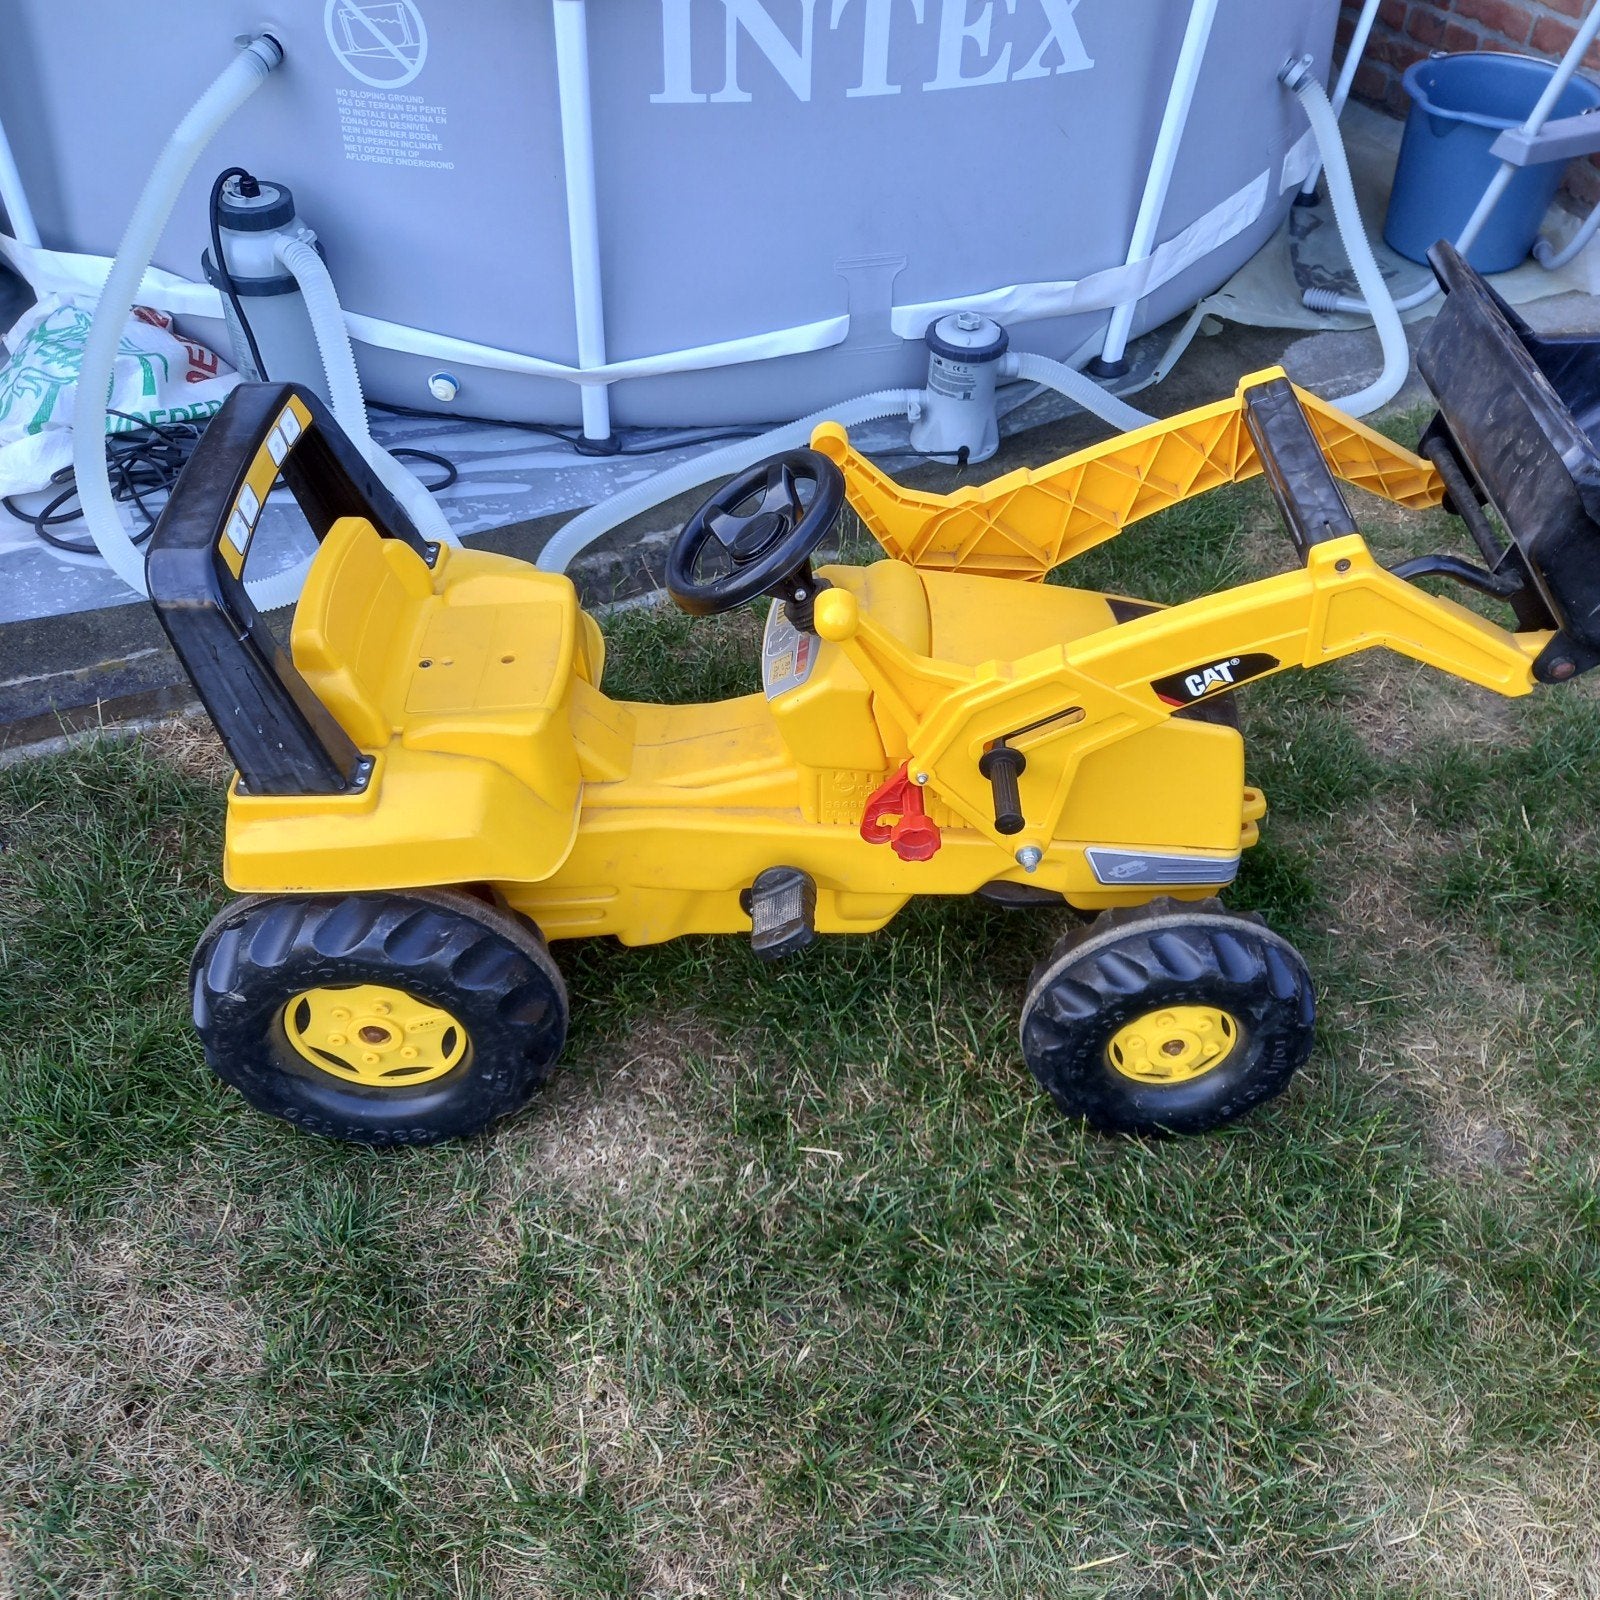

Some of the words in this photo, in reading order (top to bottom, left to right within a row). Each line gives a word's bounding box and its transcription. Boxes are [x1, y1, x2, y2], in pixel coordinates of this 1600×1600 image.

[649, 0, 1096, 103] INTEX
[336, 88, 348, 97] NO
[350, 90, 386, 101] SLOPING
[388, 93, 424, 104] GROUND
[337, 97, 353, 107] PAS
[355, 99, 367, 108] DE
[368, 101, 404, 112] TERRAIN
[406, 104, 418, 113] EN
[420, 105, 447, 115] PENTE
[339, 107, 351, 115] NO
[353, 109, 387, 120] INSTALE
[389, 112, 399, 120] LA
[401, 113, 434, 124] PISCINA
[436, 116, 447, 124] EN
[341, 116, 369, 126] ZONAS
[371, 119, 388, 128] CON
[390, 121, 430, 132] DESNIVEL
[342, 125, 361, 134] KEIN
[363, 128, 407, 139] UNEBENER
[409, 132, 438, 142] BODEN
[343, 134, 355, 143] NO
[357, 136, 399, 147] SUPERFICI
[401, 140, 443, 151] INCLINATE
[345, 144, 361, 152] NIET
[364, 145, 406, 157] OPZETTEN
[408, 150, 420, 158] OP
[346, 152, 394, 165] AFLOPENDE
[396, 158, 455, 170] ONDERGROND
